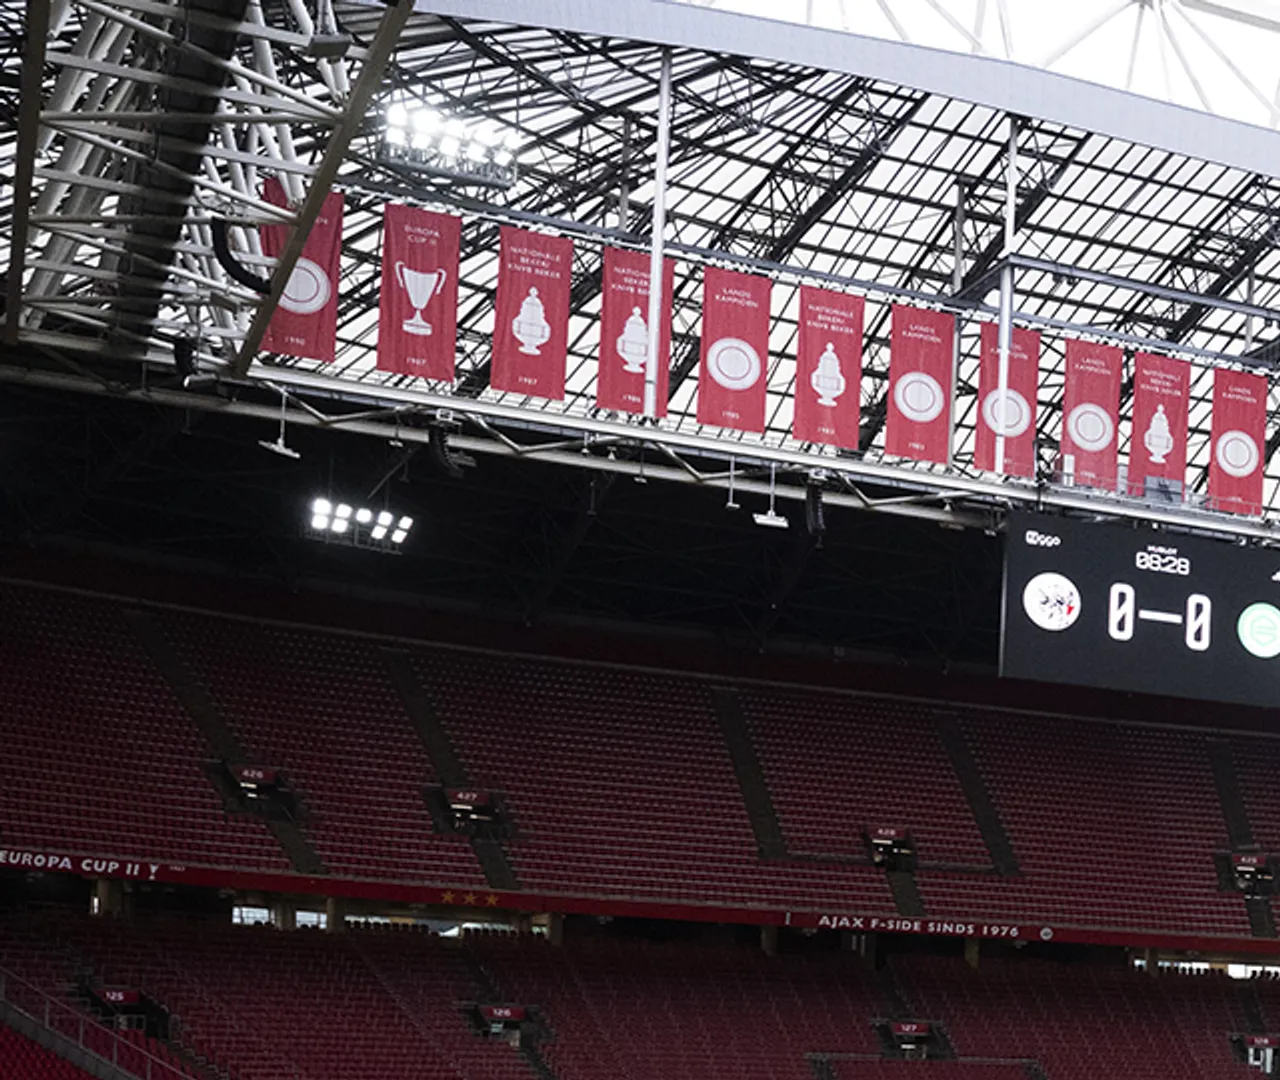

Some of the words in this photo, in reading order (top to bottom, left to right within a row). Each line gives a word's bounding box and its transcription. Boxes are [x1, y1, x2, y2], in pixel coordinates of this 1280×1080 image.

[509, 245, 562, 263] NATIONALE
[714, 293, 760, 309] KAMPIOEN
[81, 859, 120, 874] CUP
[818, 914, 864, 929] AJAX
[870, 917, 922, 933] F-SIDE
[928, 922, 975, 935] SINDS
[981, 925, 1019, 938] 1976
